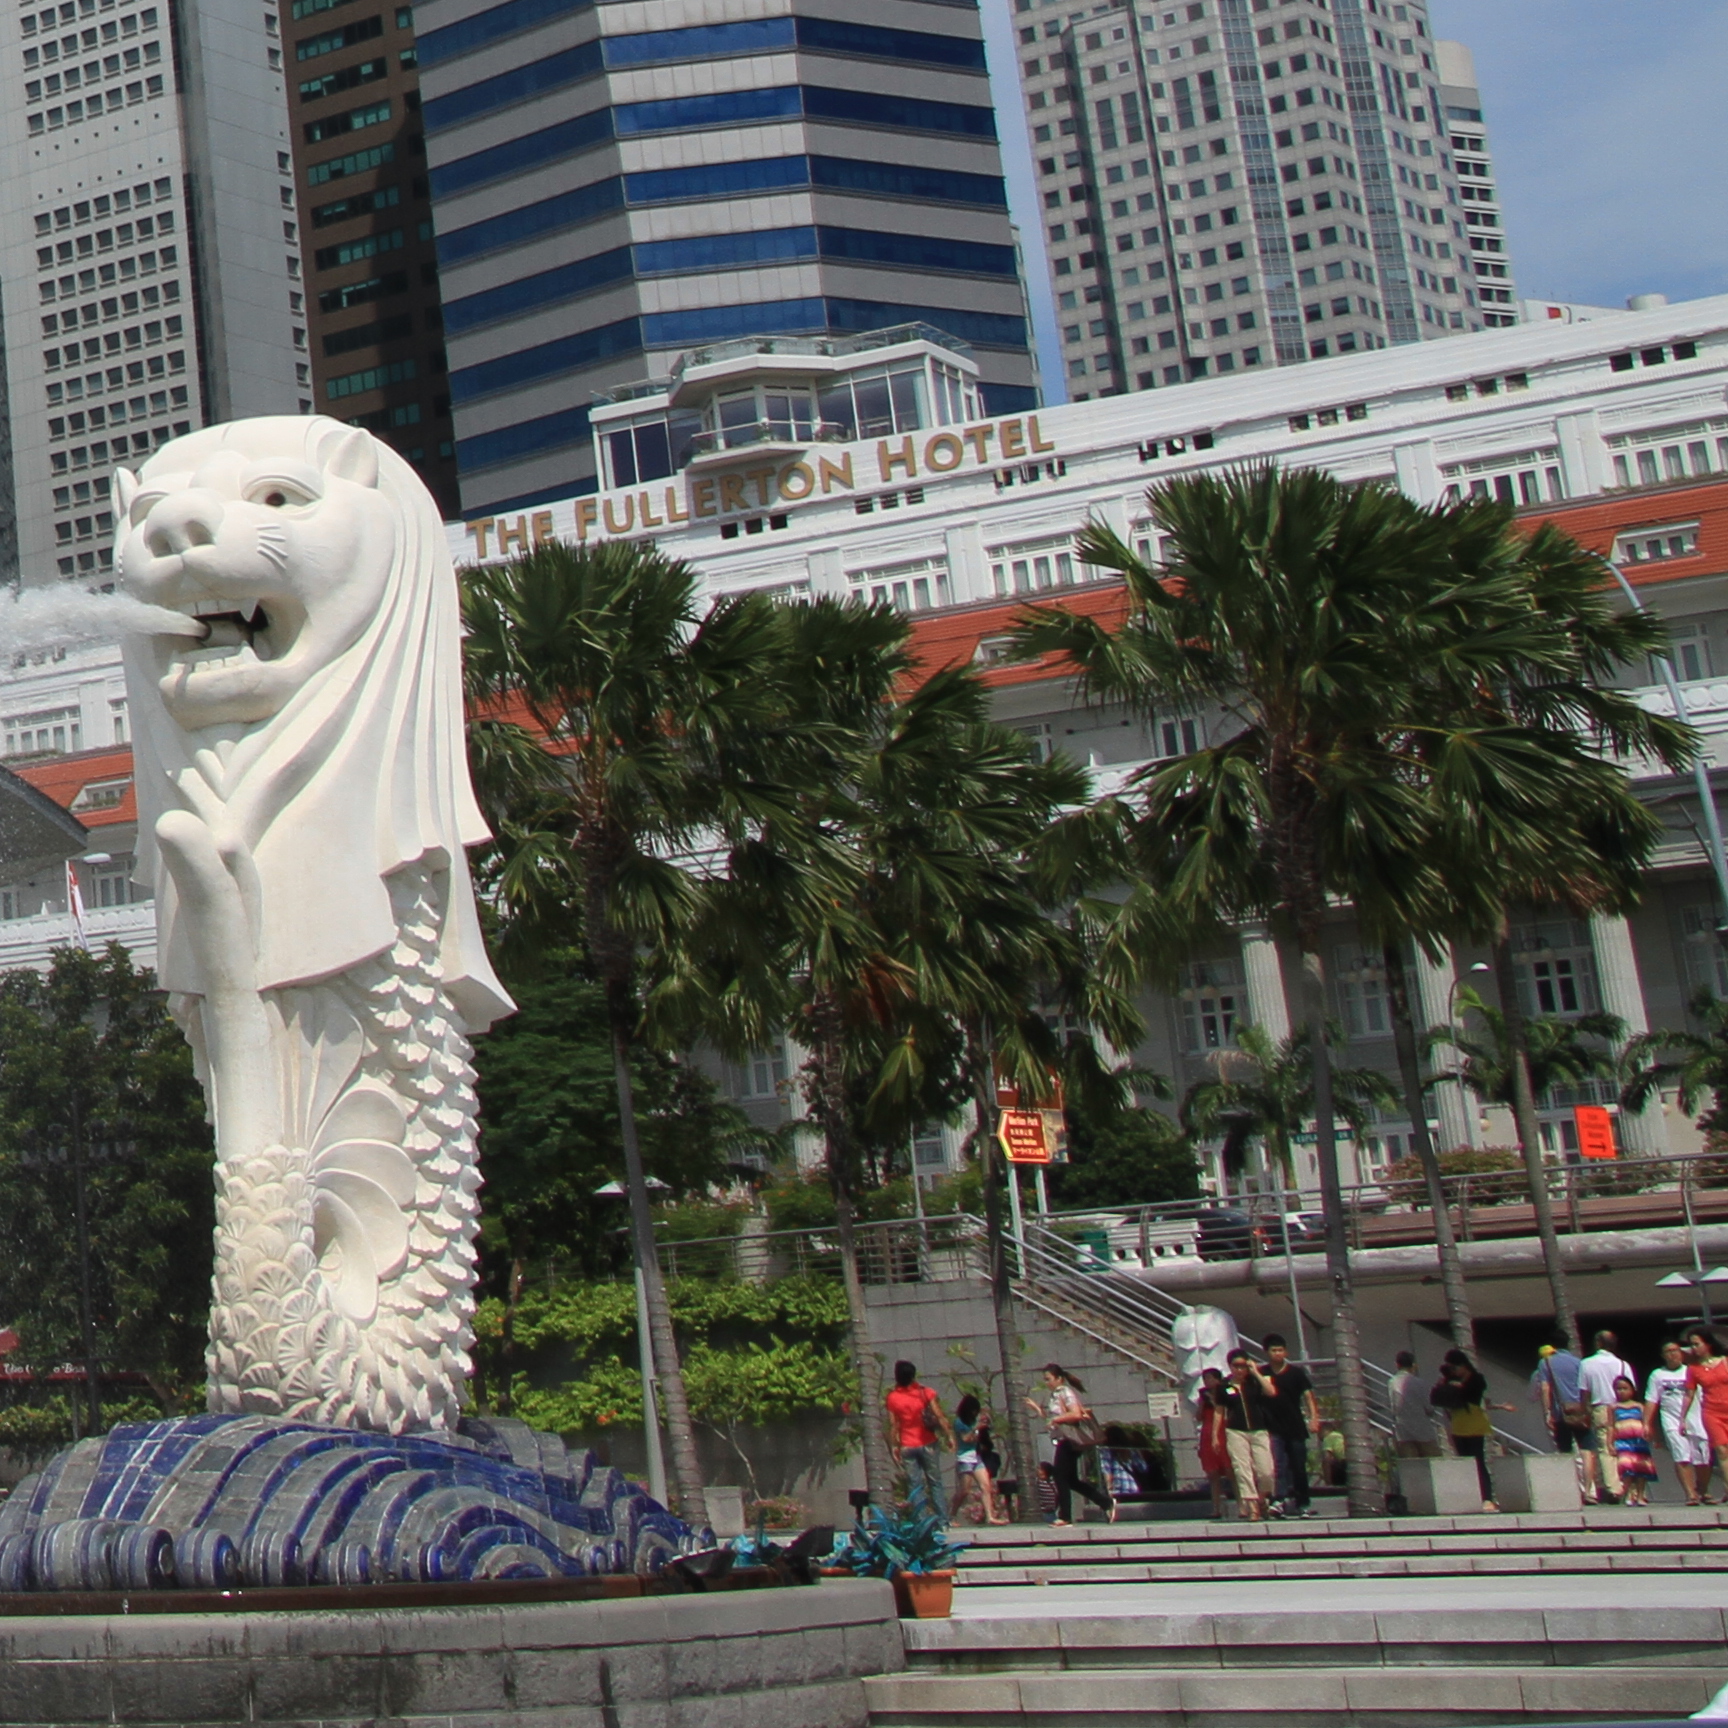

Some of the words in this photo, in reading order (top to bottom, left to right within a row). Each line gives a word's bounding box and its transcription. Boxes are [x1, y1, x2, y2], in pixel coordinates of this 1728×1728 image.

[465, 510, 554, 560] THE
[575, 451, 854, 541] FULLERTON
[877, 415, 1055, 483] HOTEL
